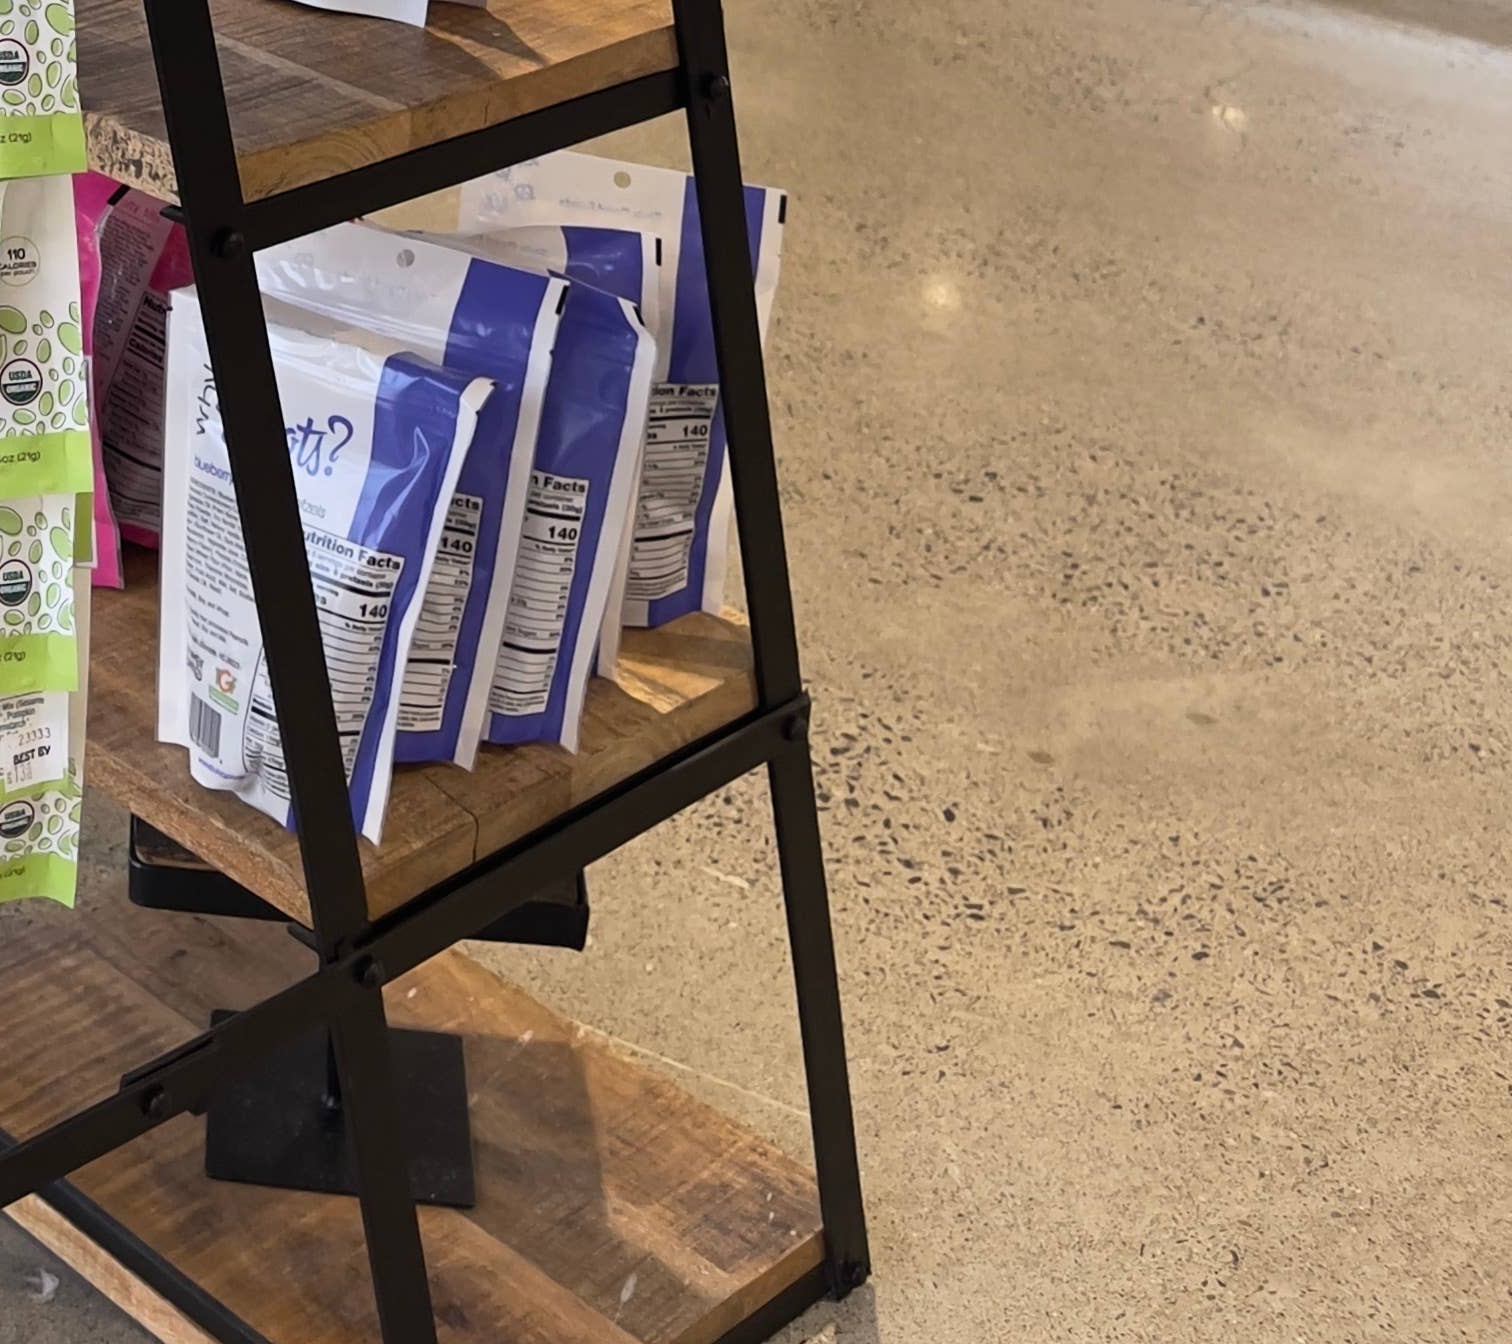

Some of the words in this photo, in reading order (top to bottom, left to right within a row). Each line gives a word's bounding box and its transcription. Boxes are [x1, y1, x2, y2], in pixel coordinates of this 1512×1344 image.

[7, 247, 27, 261] 110
[9, 369, 33, 382] USDA
[678, 386, 717, 398] Facts
[683, 425, 708, 437] 140
[544, 476, 586, 494] Facts
[547, 525, 578, 540] 140
[441, 536, 473, 553] 140
[358, 550, 401, 571] Facts
[359, 603, 387, 619] 140
[13, 749, 36, 766] BEST
[37, 745, 52, 758] BY
